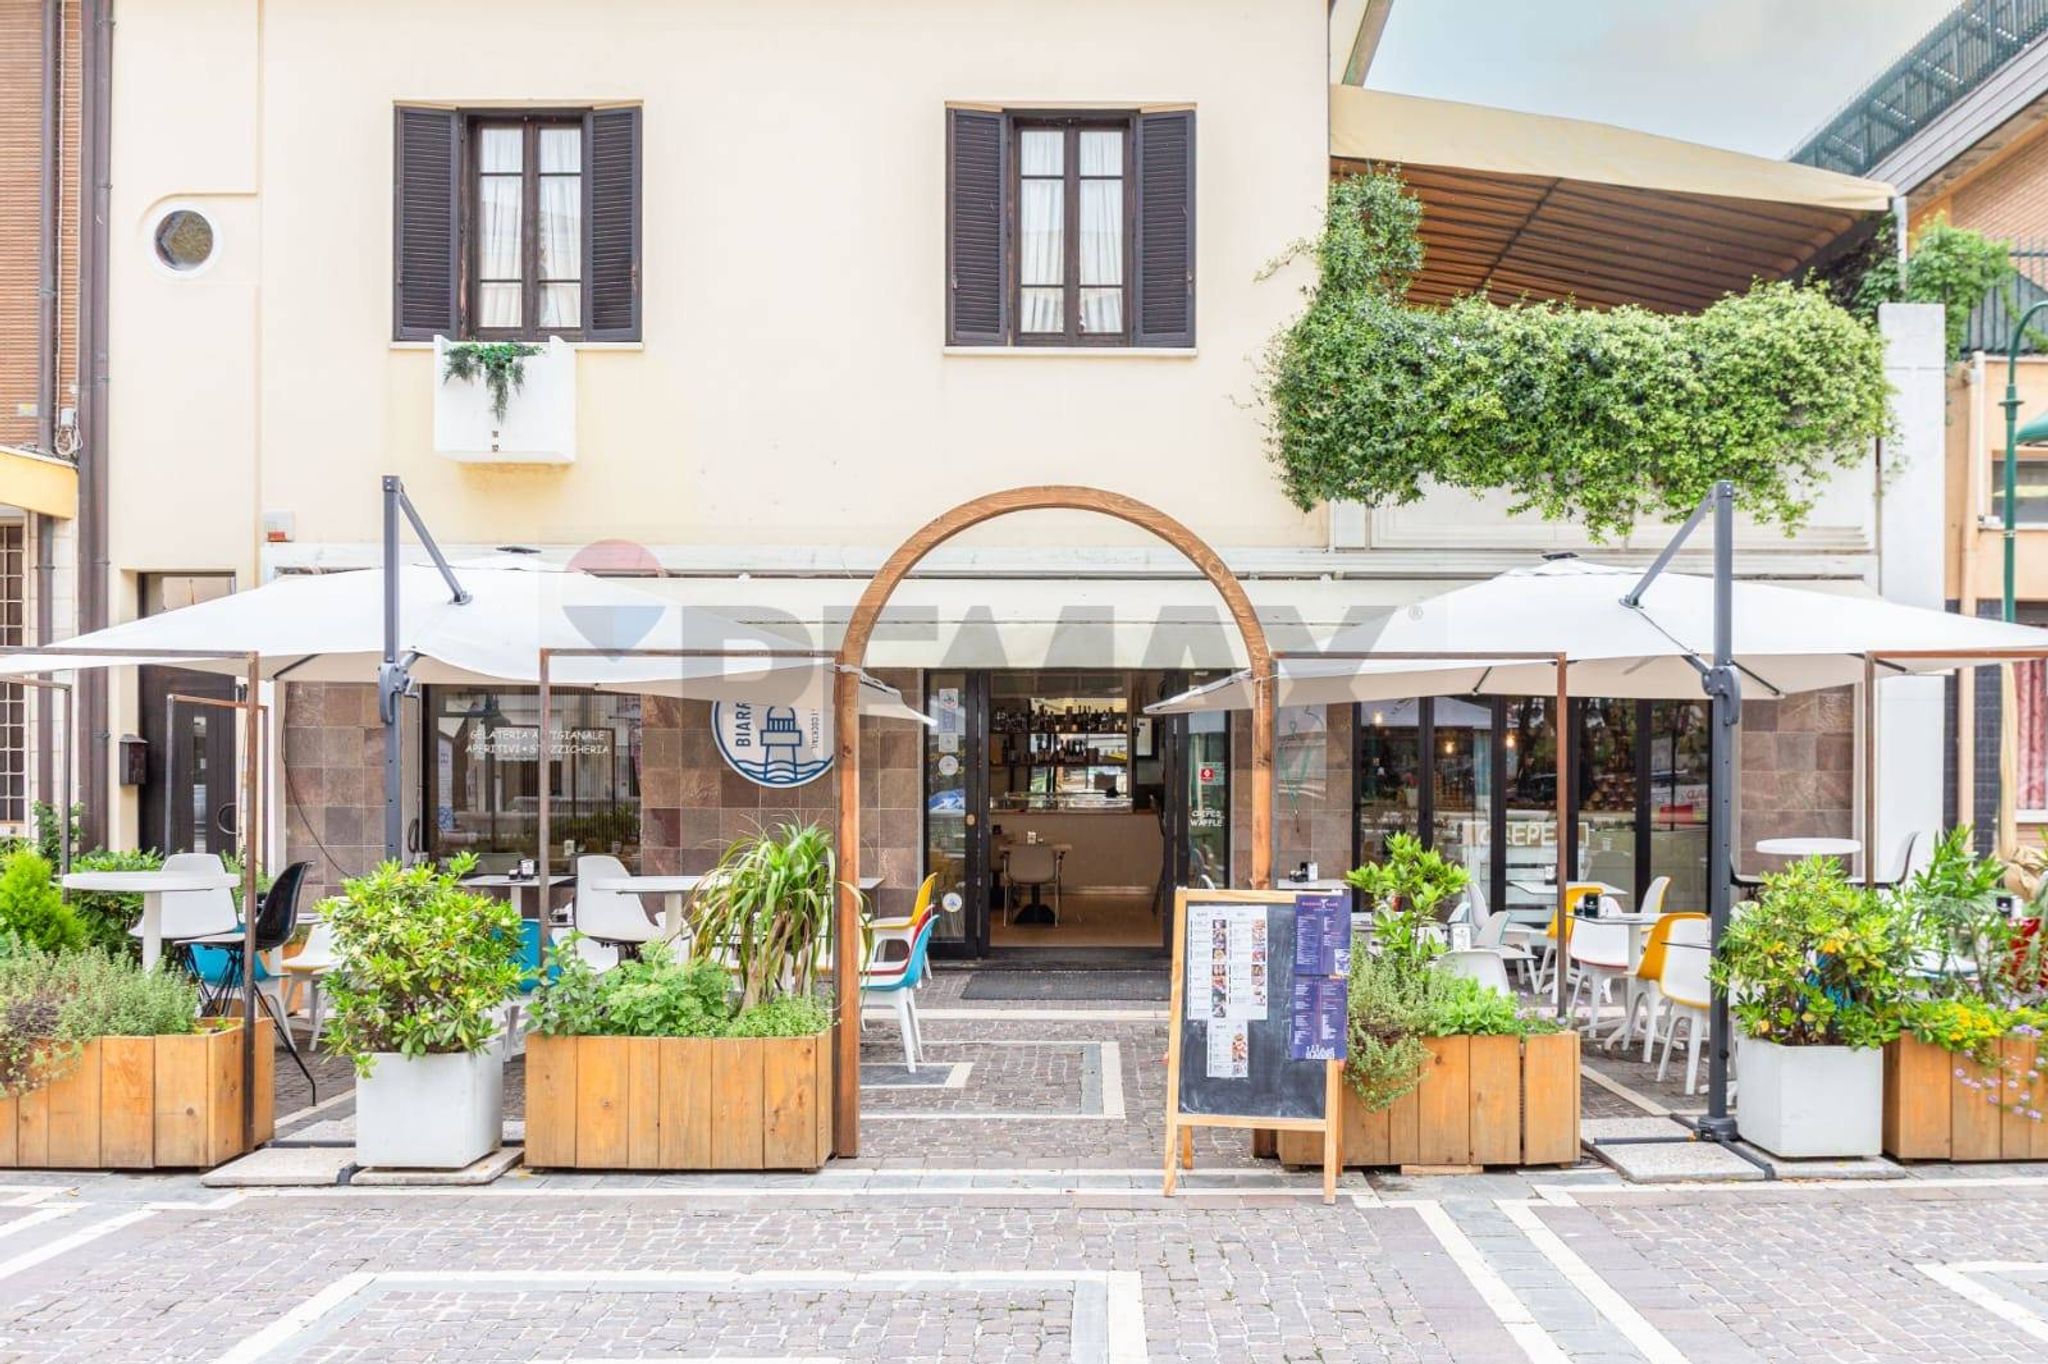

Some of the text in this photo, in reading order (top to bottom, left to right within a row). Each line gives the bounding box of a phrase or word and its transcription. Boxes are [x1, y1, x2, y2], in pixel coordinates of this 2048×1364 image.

[469, 729, 528, 740] GELATERIA
[465, 743, 609, 754] APERITIVI SZZICHERIA
